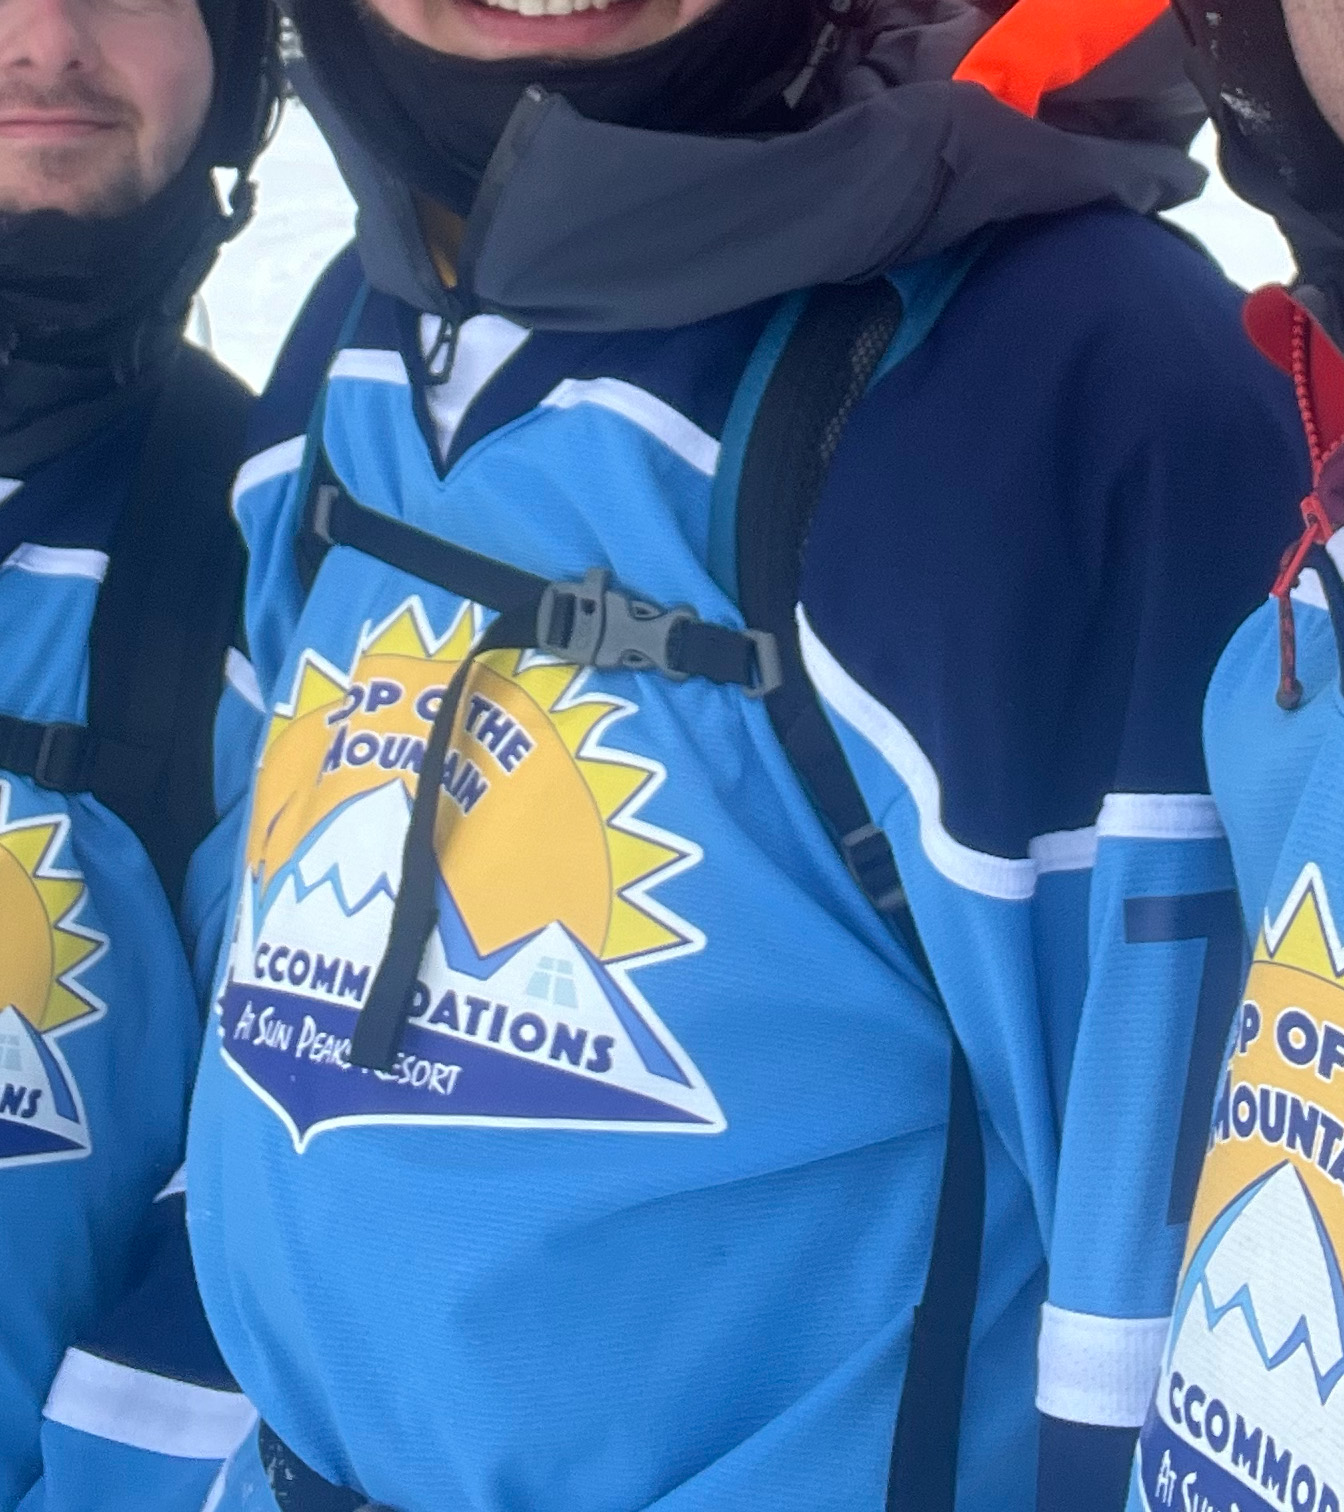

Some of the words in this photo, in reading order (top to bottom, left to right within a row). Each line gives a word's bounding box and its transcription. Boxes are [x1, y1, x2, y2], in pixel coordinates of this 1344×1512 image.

[415, 685, 449, 723] O
[465, 693, 537, 775] THE
[252, 1006, 295, 1051] SUN
